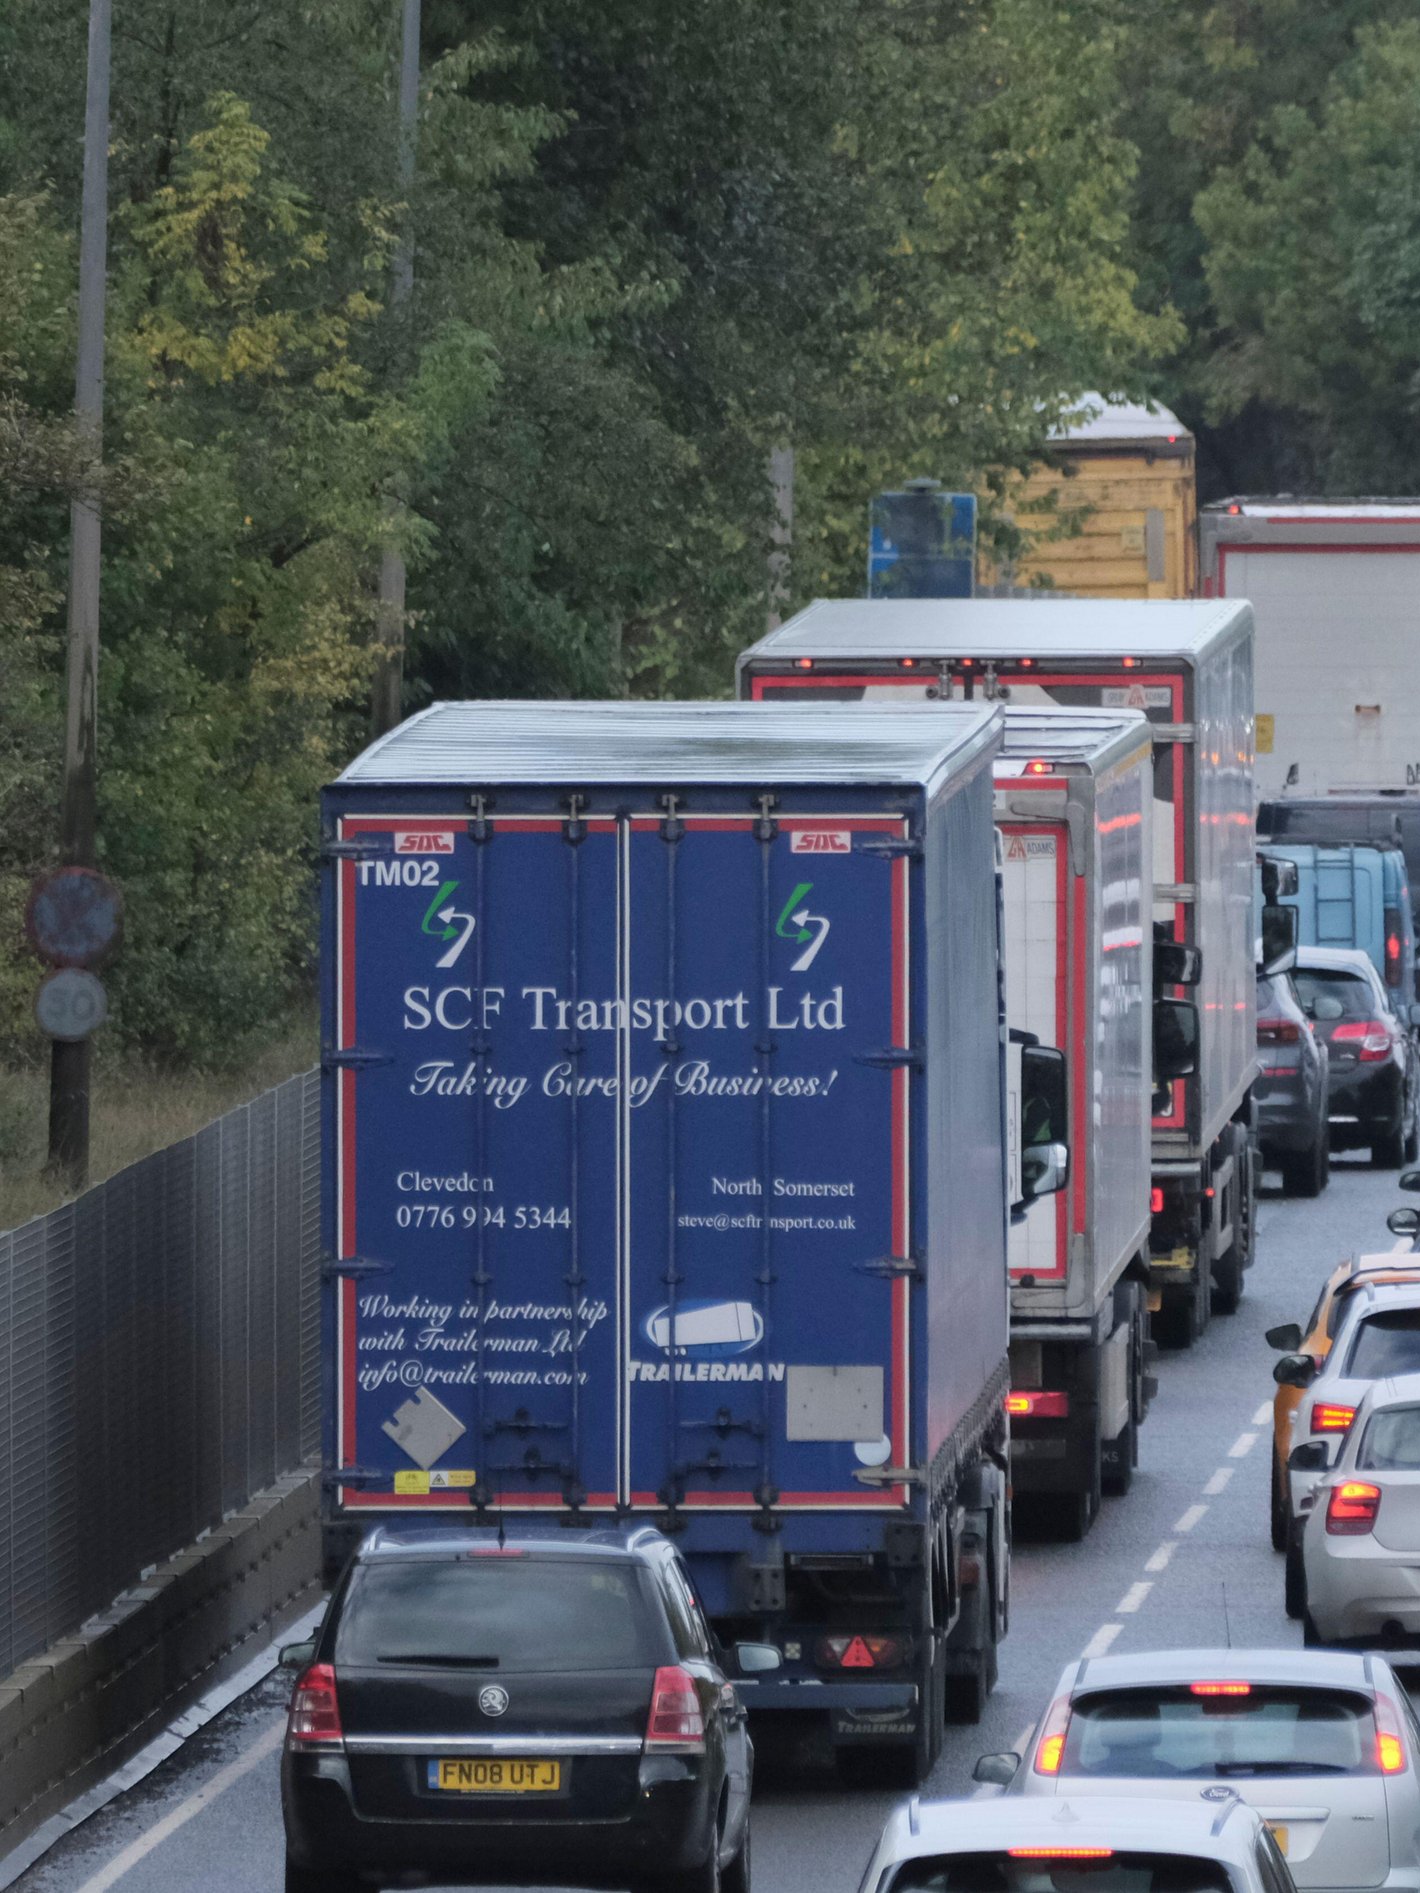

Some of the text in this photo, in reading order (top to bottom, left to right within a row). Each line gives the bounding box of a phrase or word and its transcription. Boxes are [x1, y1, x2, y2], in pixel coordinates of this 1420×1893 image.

[397, 834, 452, 852] SDC
[795, 834, 849, 851] SDC
[1027, 842, 1055, 855] ADAMS
[355, 860, 440, 886] TM02
[403, 986, 846, 1042] SCF Transport Ltd
[410, 1061, 532, 1109] Taking
[543, 1061, 618, 1097] Care
[628, 1063, 670, 1109] of
[397, 1171, 495, 1192] Clevedon
[712, 1177, 855, 1197] North Somerset
[396, 1205, 455, 1228] 0776
[514, 1206, 572, 1229] 5344
[678, 1213, 856, 1232] steve@scftrnsport.co.uk
[358, 1294, 452, 1327] Working
[459, 1300, 479, 1319] in
[358, 1328, 406, 1351] with
[629, 1361, 786, 1382] TRAILERMAN
[443, 1762, 555, 1785] FN08 UTJ
